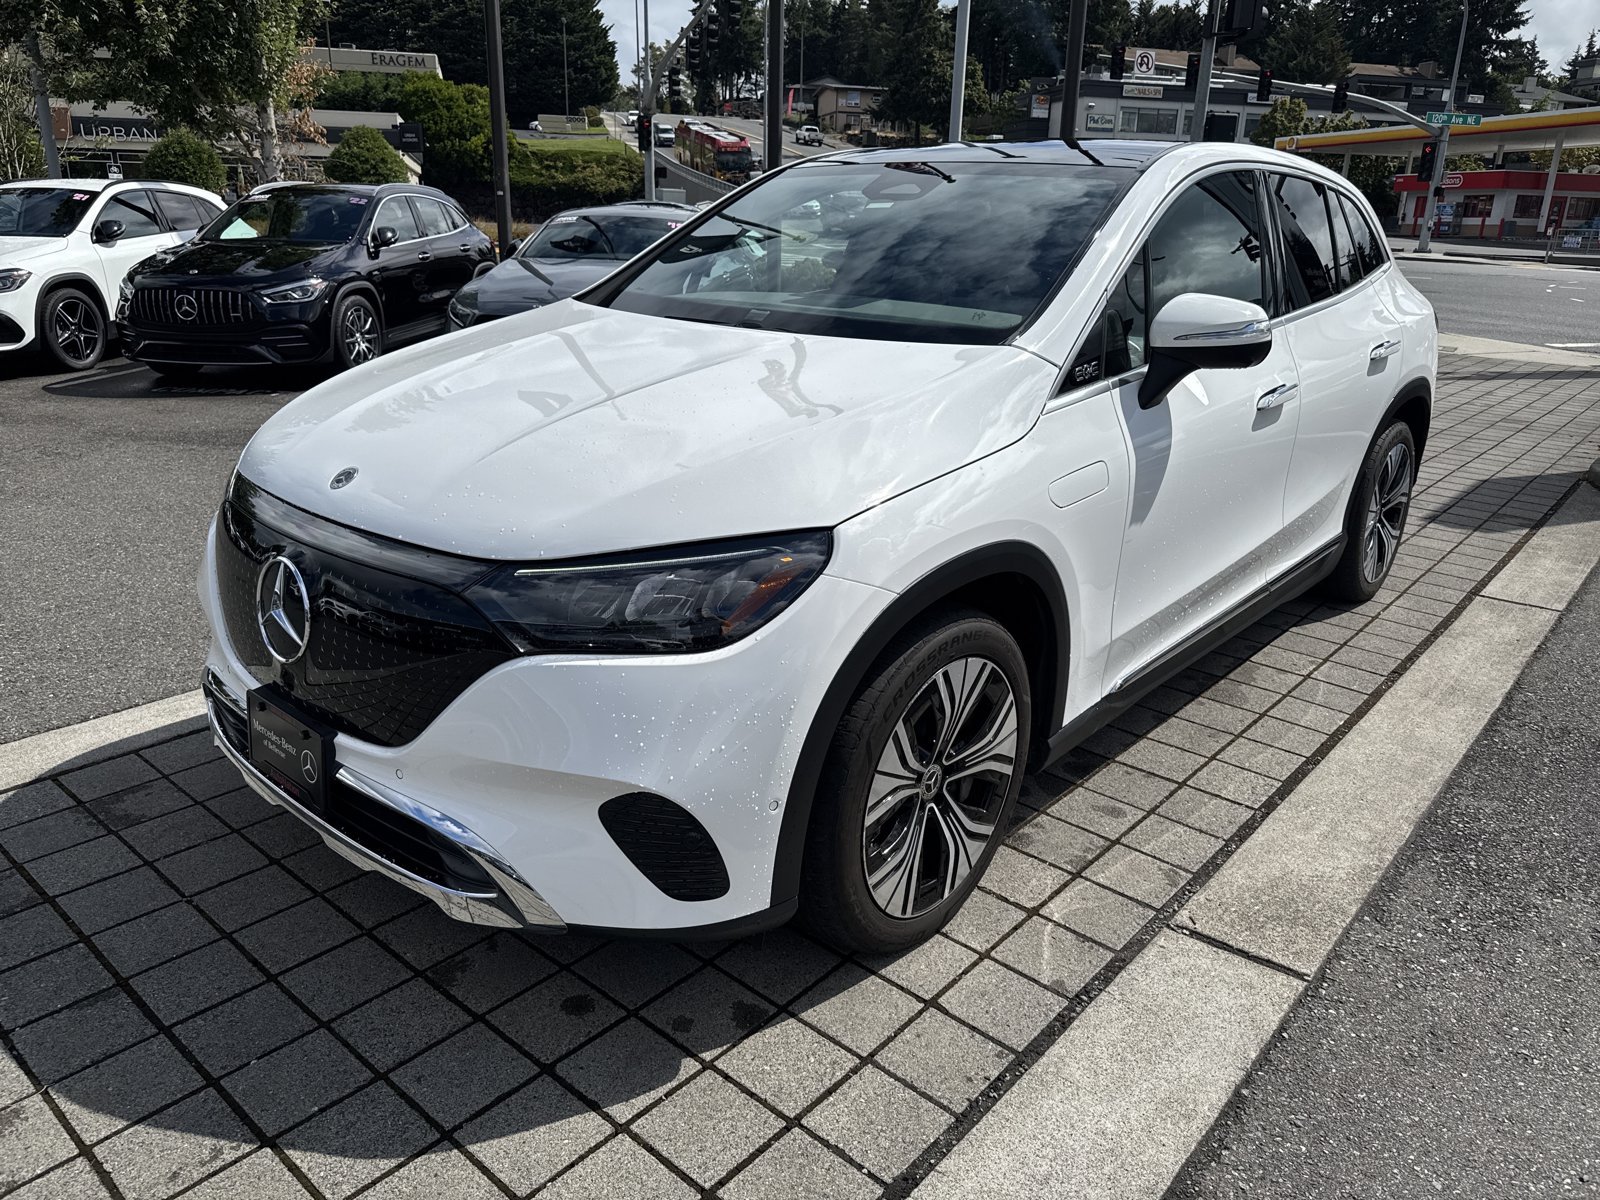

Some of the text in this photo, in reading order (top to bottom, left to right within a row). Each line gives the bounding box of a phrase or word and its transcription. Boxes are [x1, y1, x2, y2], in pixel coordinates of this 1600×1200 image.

[371, 53, 426, 67] ERAGEM
[1432, 114, 1476, 124] 120th Ave NE
[80, 123, 159, 142] URBAN
[1075, 361, 1099, 381] EQE
[253, 718, 296, 755] Mercedes-Benz
